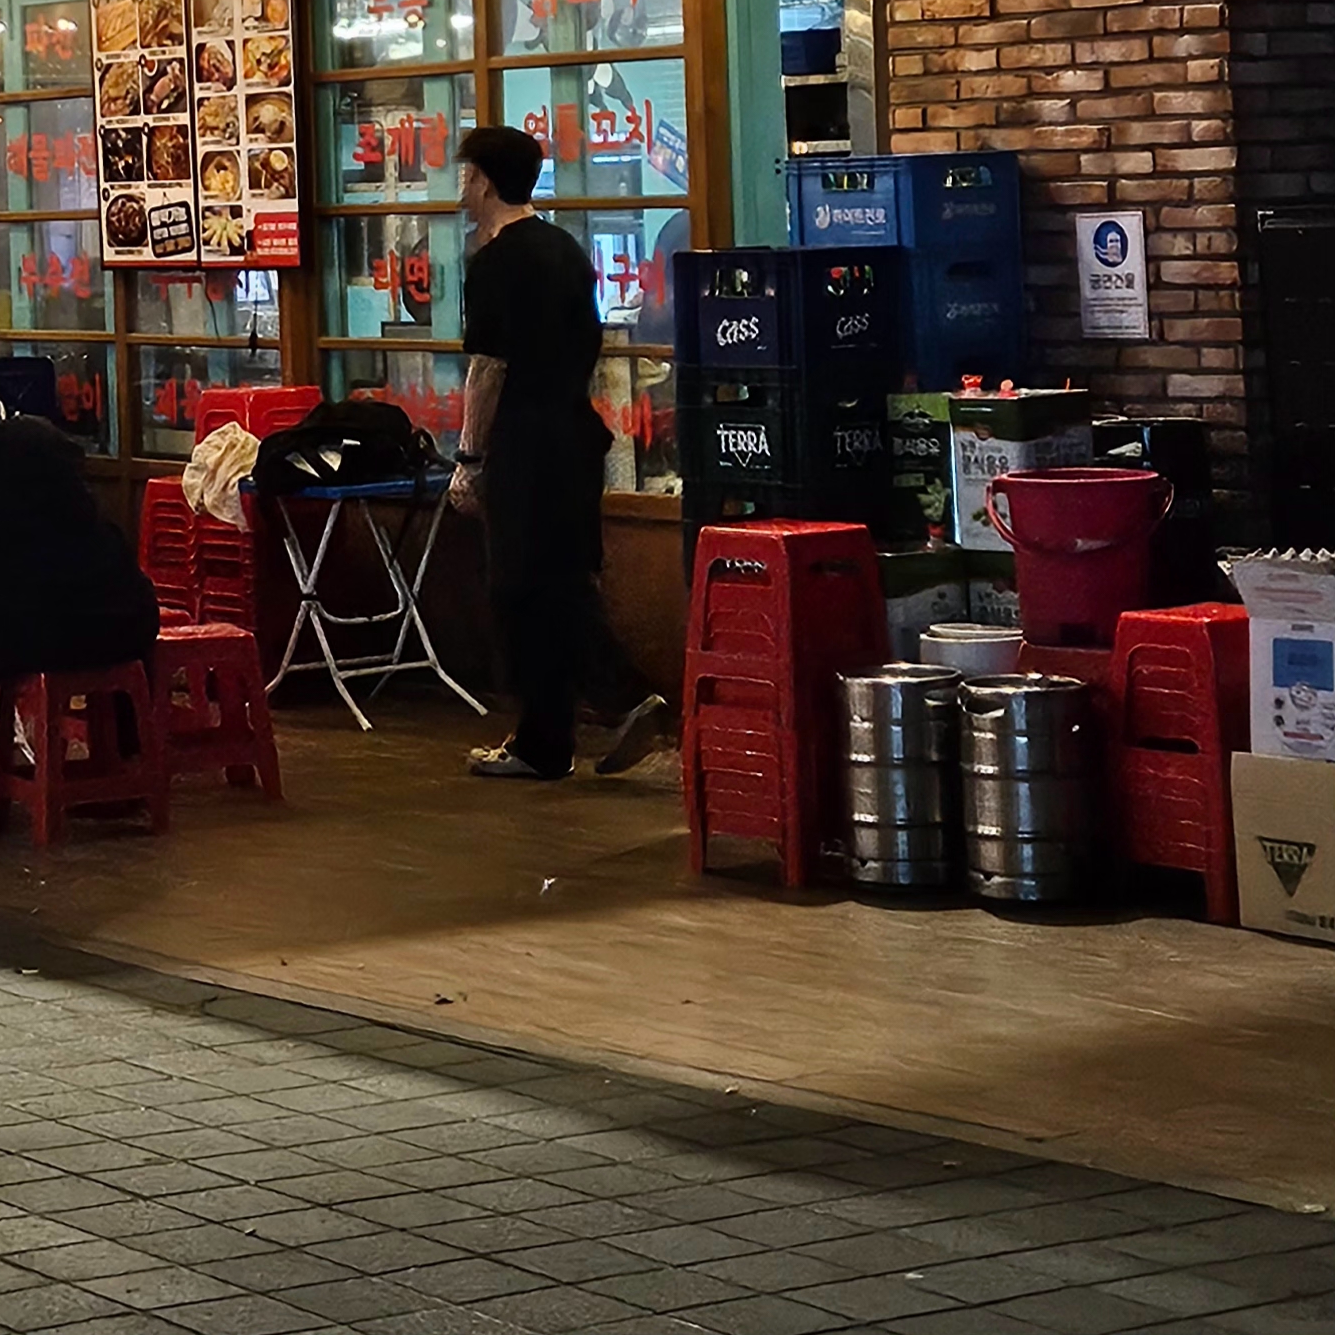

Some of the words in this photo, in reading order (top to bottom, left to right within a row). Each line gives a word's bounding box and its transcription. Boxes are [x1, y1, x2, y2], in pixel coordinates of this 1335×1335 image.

[352, 112, 449, 168] 조개탕
[372, 249, 431, 303] 라면
[716, 426, 771, 458] TERRA
